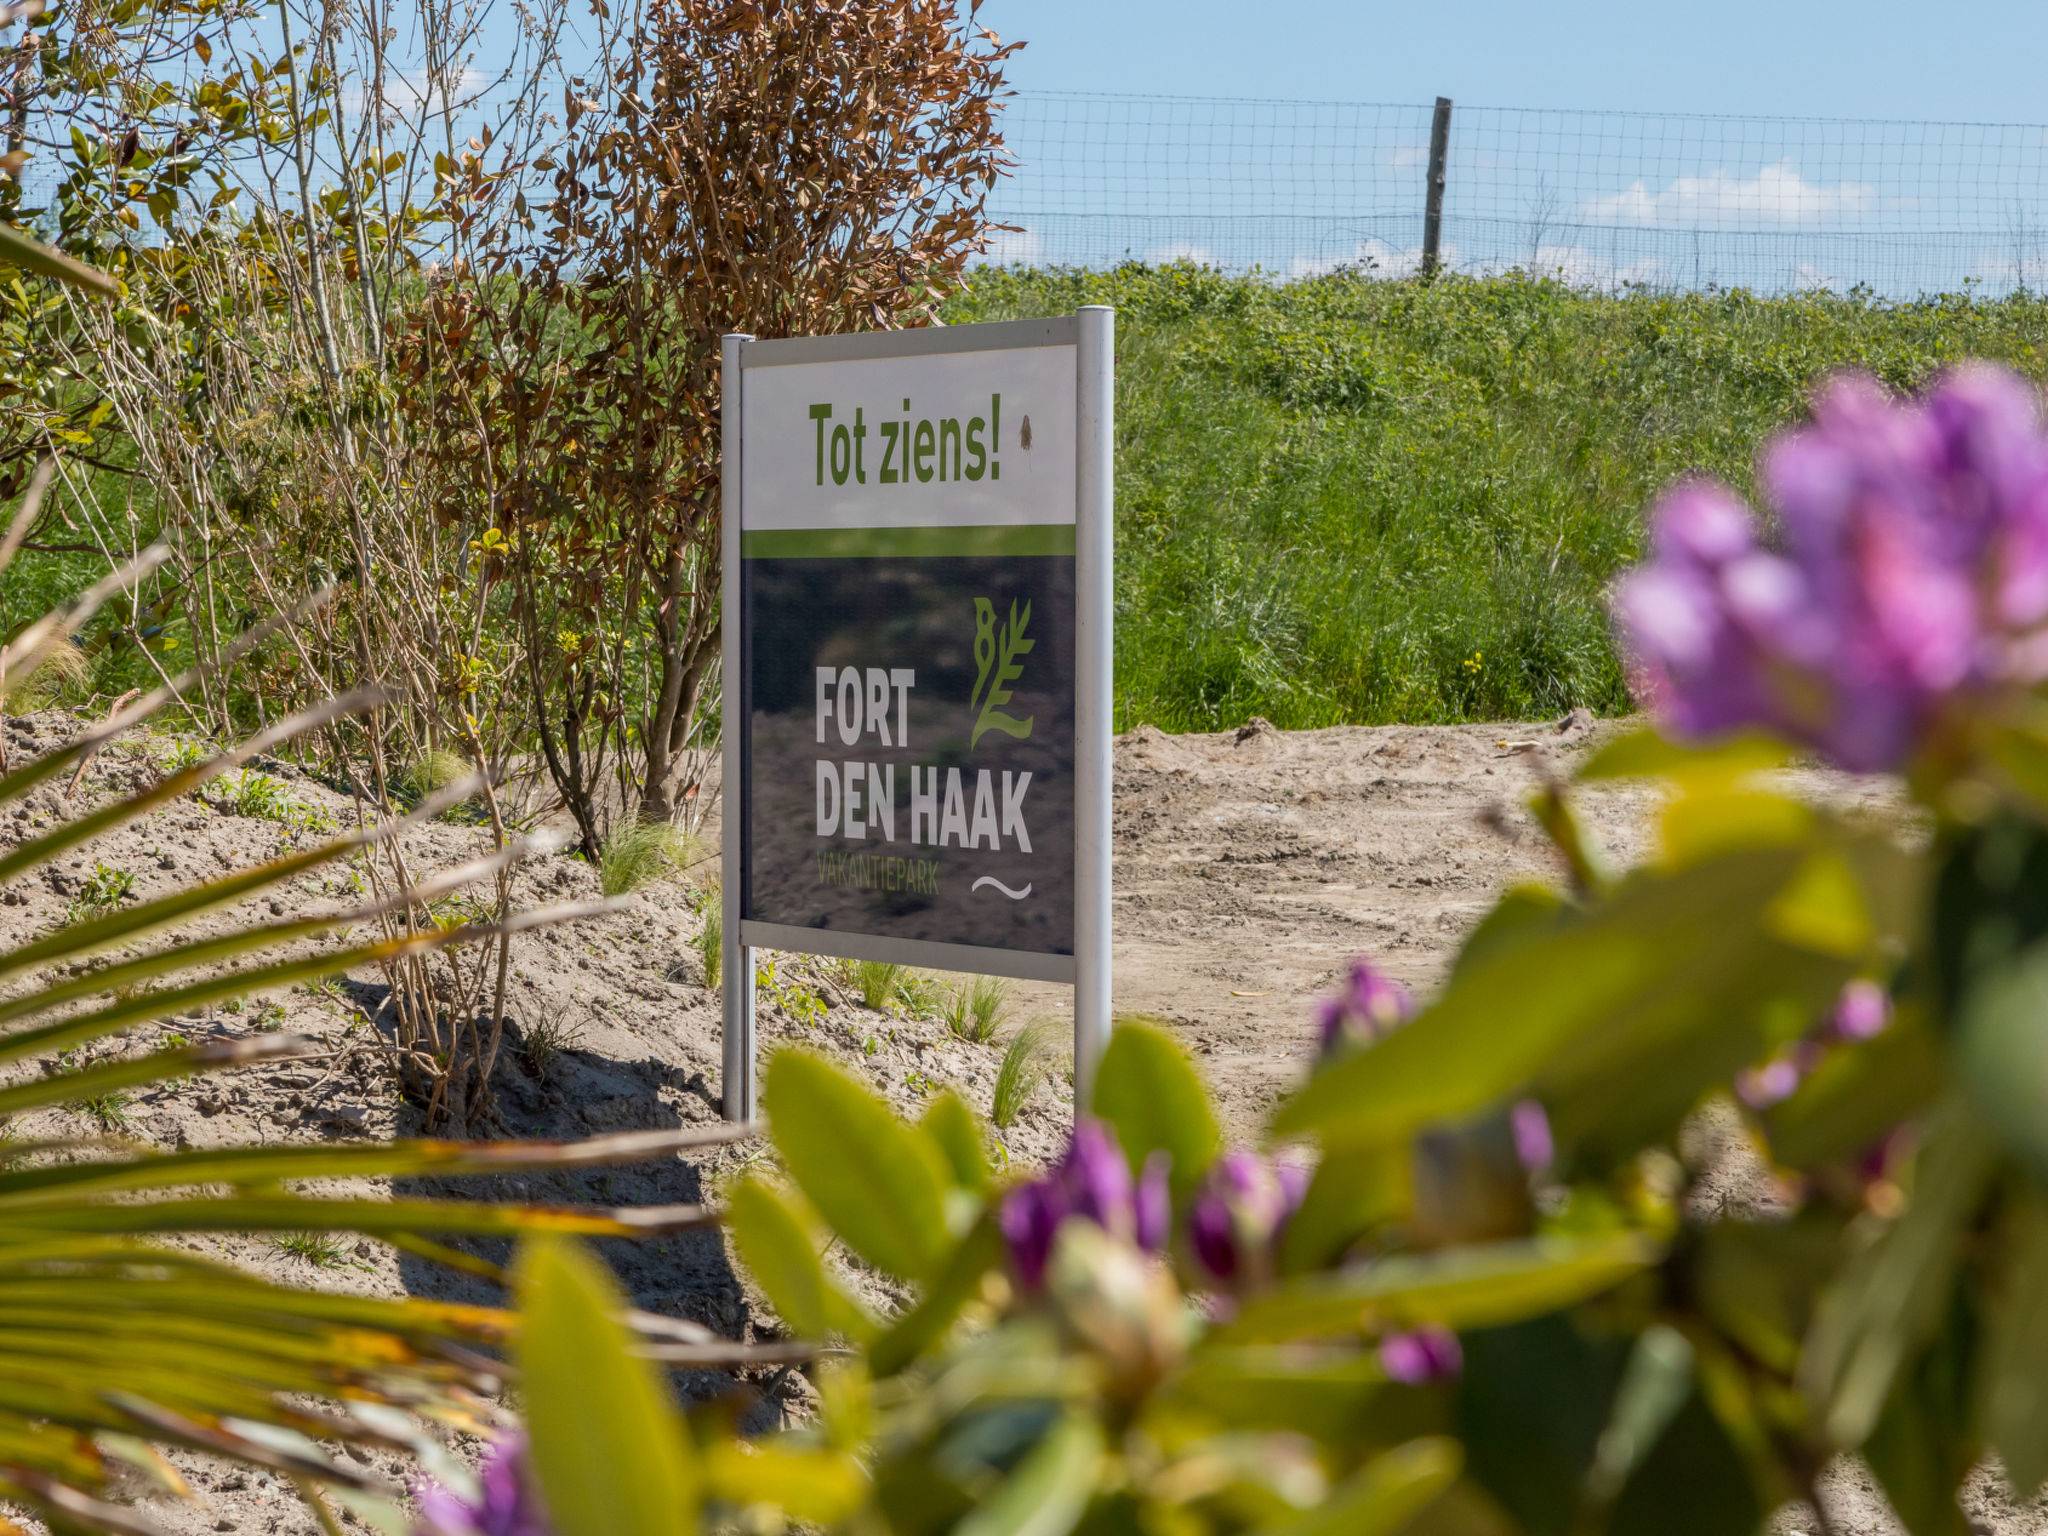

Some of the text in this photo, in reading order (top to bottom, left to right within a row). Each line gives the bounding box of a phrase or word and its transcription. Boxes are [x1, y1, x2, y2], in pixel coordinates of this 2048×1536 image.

[809, 393, 1001, 486] Tot ziens!
[816, 666, 915, 747] FORT
[816, 760, 1033, 853] DEN HAAK
[816, 849, 940, 895] VAKANTIEPARK
